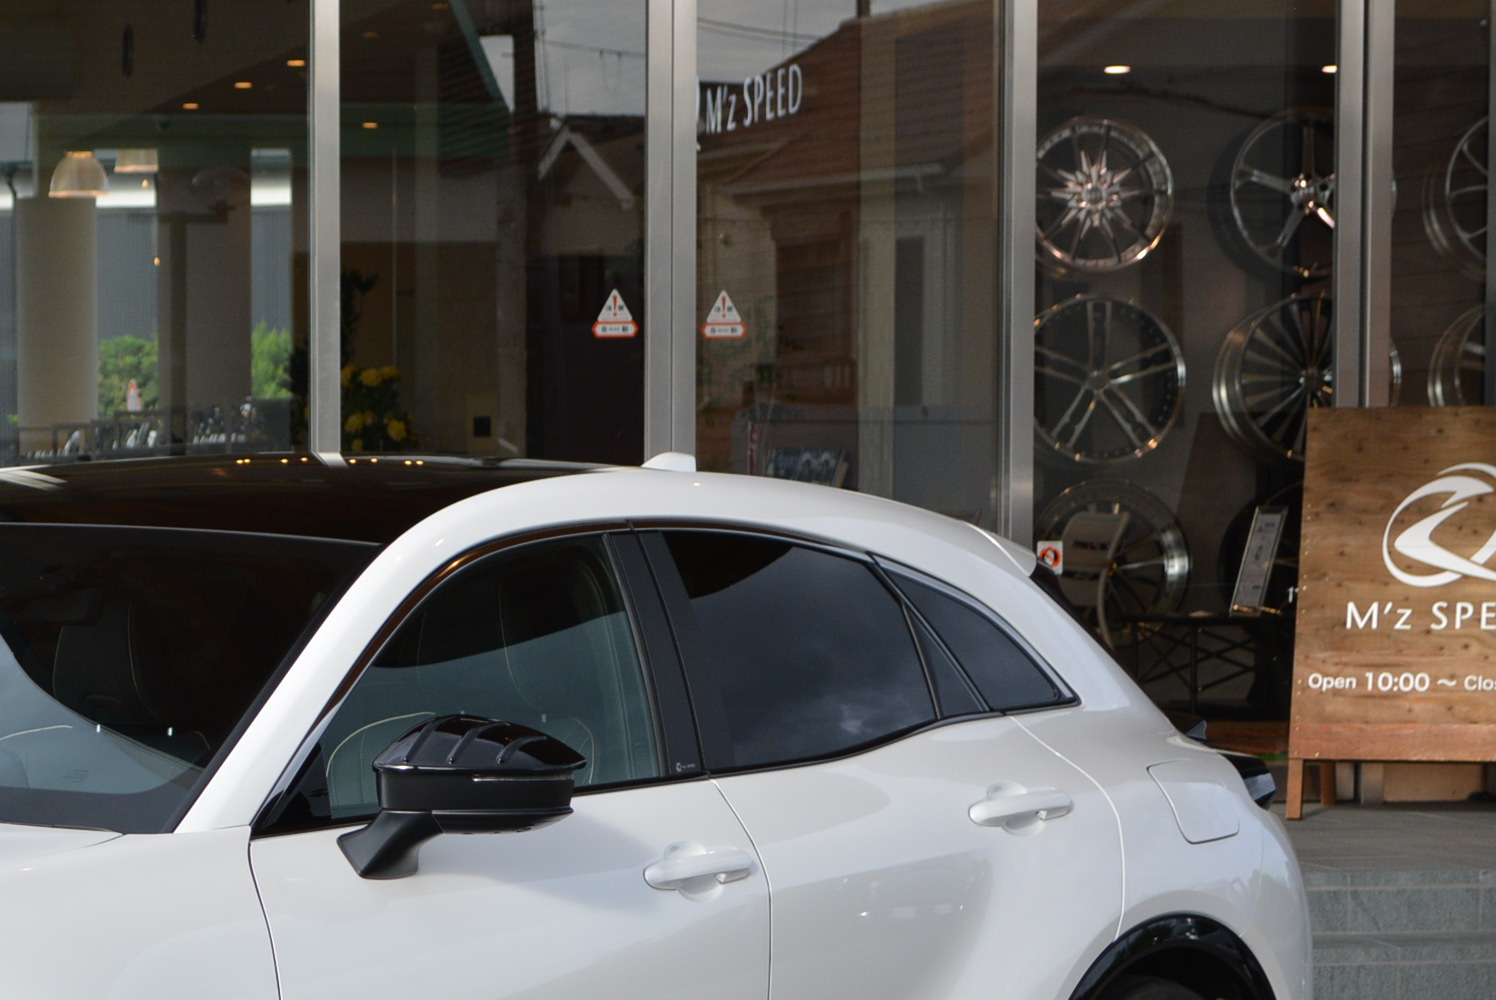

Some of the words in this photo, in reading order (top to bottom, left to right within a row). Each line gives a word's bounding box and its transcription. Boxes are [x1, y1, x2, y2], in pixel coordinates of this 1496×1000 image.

[706, 85, 737, 134] M'z
[743, 64, 803, 127] SPEED
[1346, 601, 1413, 630] M'z
[1308, 673, 1357, 692] Open
[1364, 672, 1431, 692] 10:00
[1464, 674, 1496, 691] Clo
